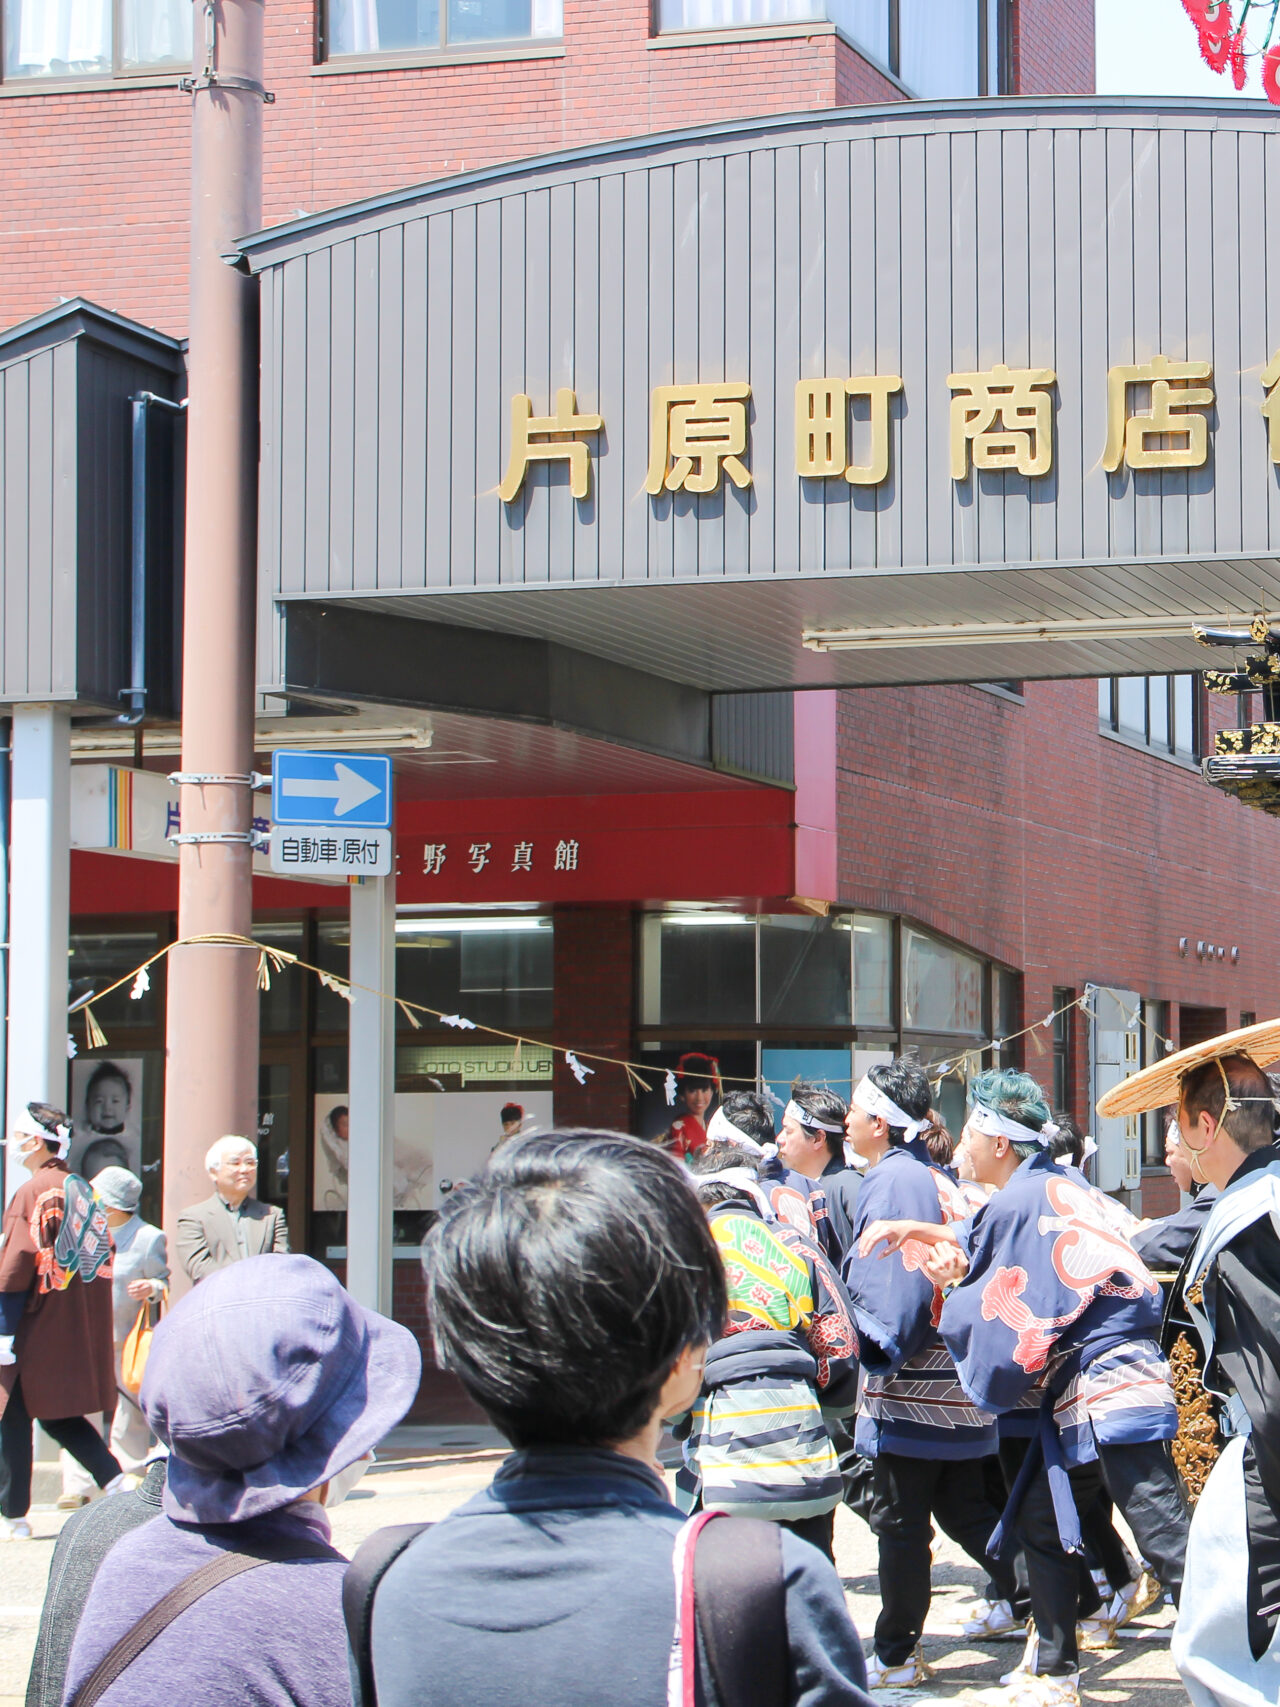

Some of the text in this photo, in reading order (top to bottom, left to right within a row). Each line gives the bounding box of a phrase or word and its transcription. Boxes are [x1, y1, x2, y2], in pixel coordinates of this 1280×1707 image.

[396, 839, 580, 875] 野写真館
[464, 1061, 523, 1073] STUDIO
